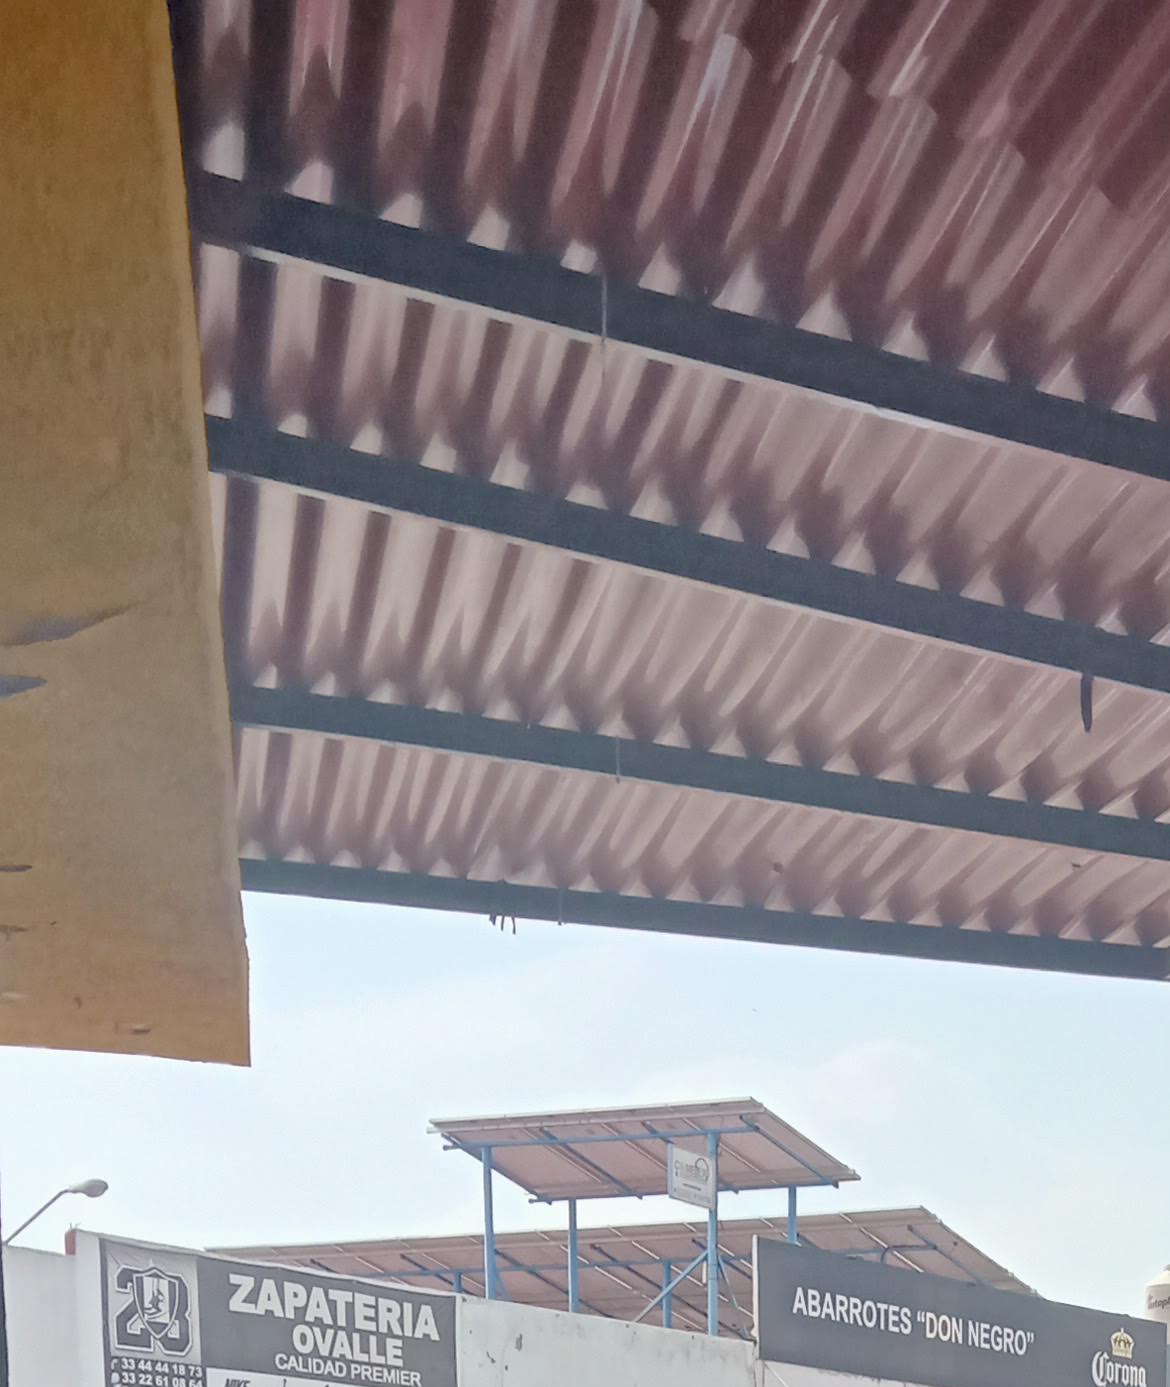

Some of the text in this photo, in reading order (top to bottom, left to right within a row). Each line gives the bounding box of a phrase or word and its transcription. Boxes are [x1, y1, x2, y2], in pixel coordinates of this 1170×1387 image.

[228, 1273, 440, 1341] ZAPATERIA
[792, 1286, 912, 1335] ABARROTES
[292, 1324, 404, 1367] OVALLE
[121, 1358, 203, 1378] 33 44 44 18 73
[121, 1372, 136, 1384] 33
[138, 1373, 153, 1386] 22
[155, 1375, 169, 1387] 61
[275, 1353, 423, 1387] CALIDAD PREMIER
